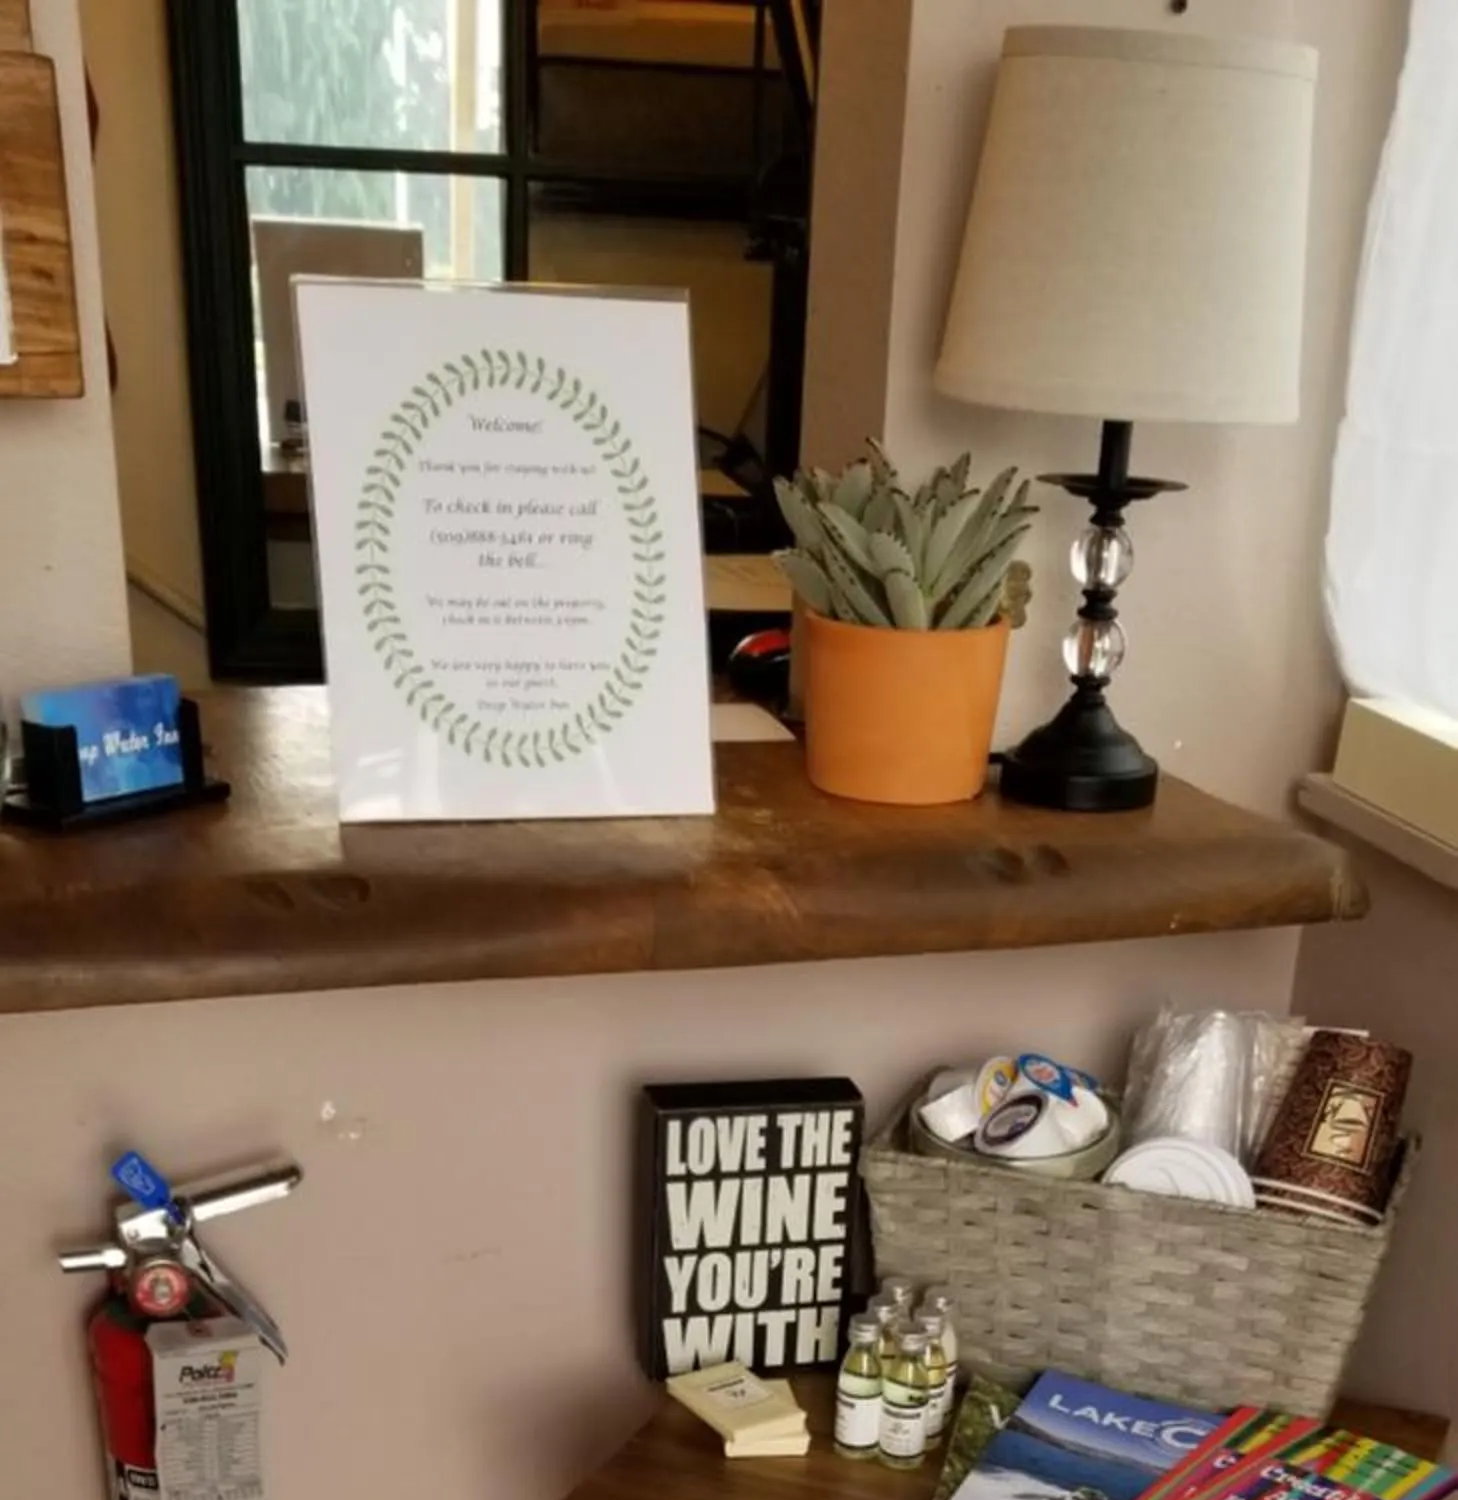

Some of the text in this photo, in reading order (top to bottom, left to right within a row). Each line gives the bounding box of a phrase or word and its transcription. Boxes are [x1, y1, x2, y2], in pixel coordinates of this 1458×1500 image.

[422, 495, 599, 520] To check in please call
[478, 551, 503, 568] the
[537, 532, 555, 545] or
[559, 531, 593, 550] ring
[666, 1109, 855, 1176] LOVE THE
[665, 1172, 850, 1251] WINE
[663, 1244, 845, 1313] YOU'RE
[662, 1305, 841, 1374] WITH
[1048, 1393, 1159, 1438] LAKE
